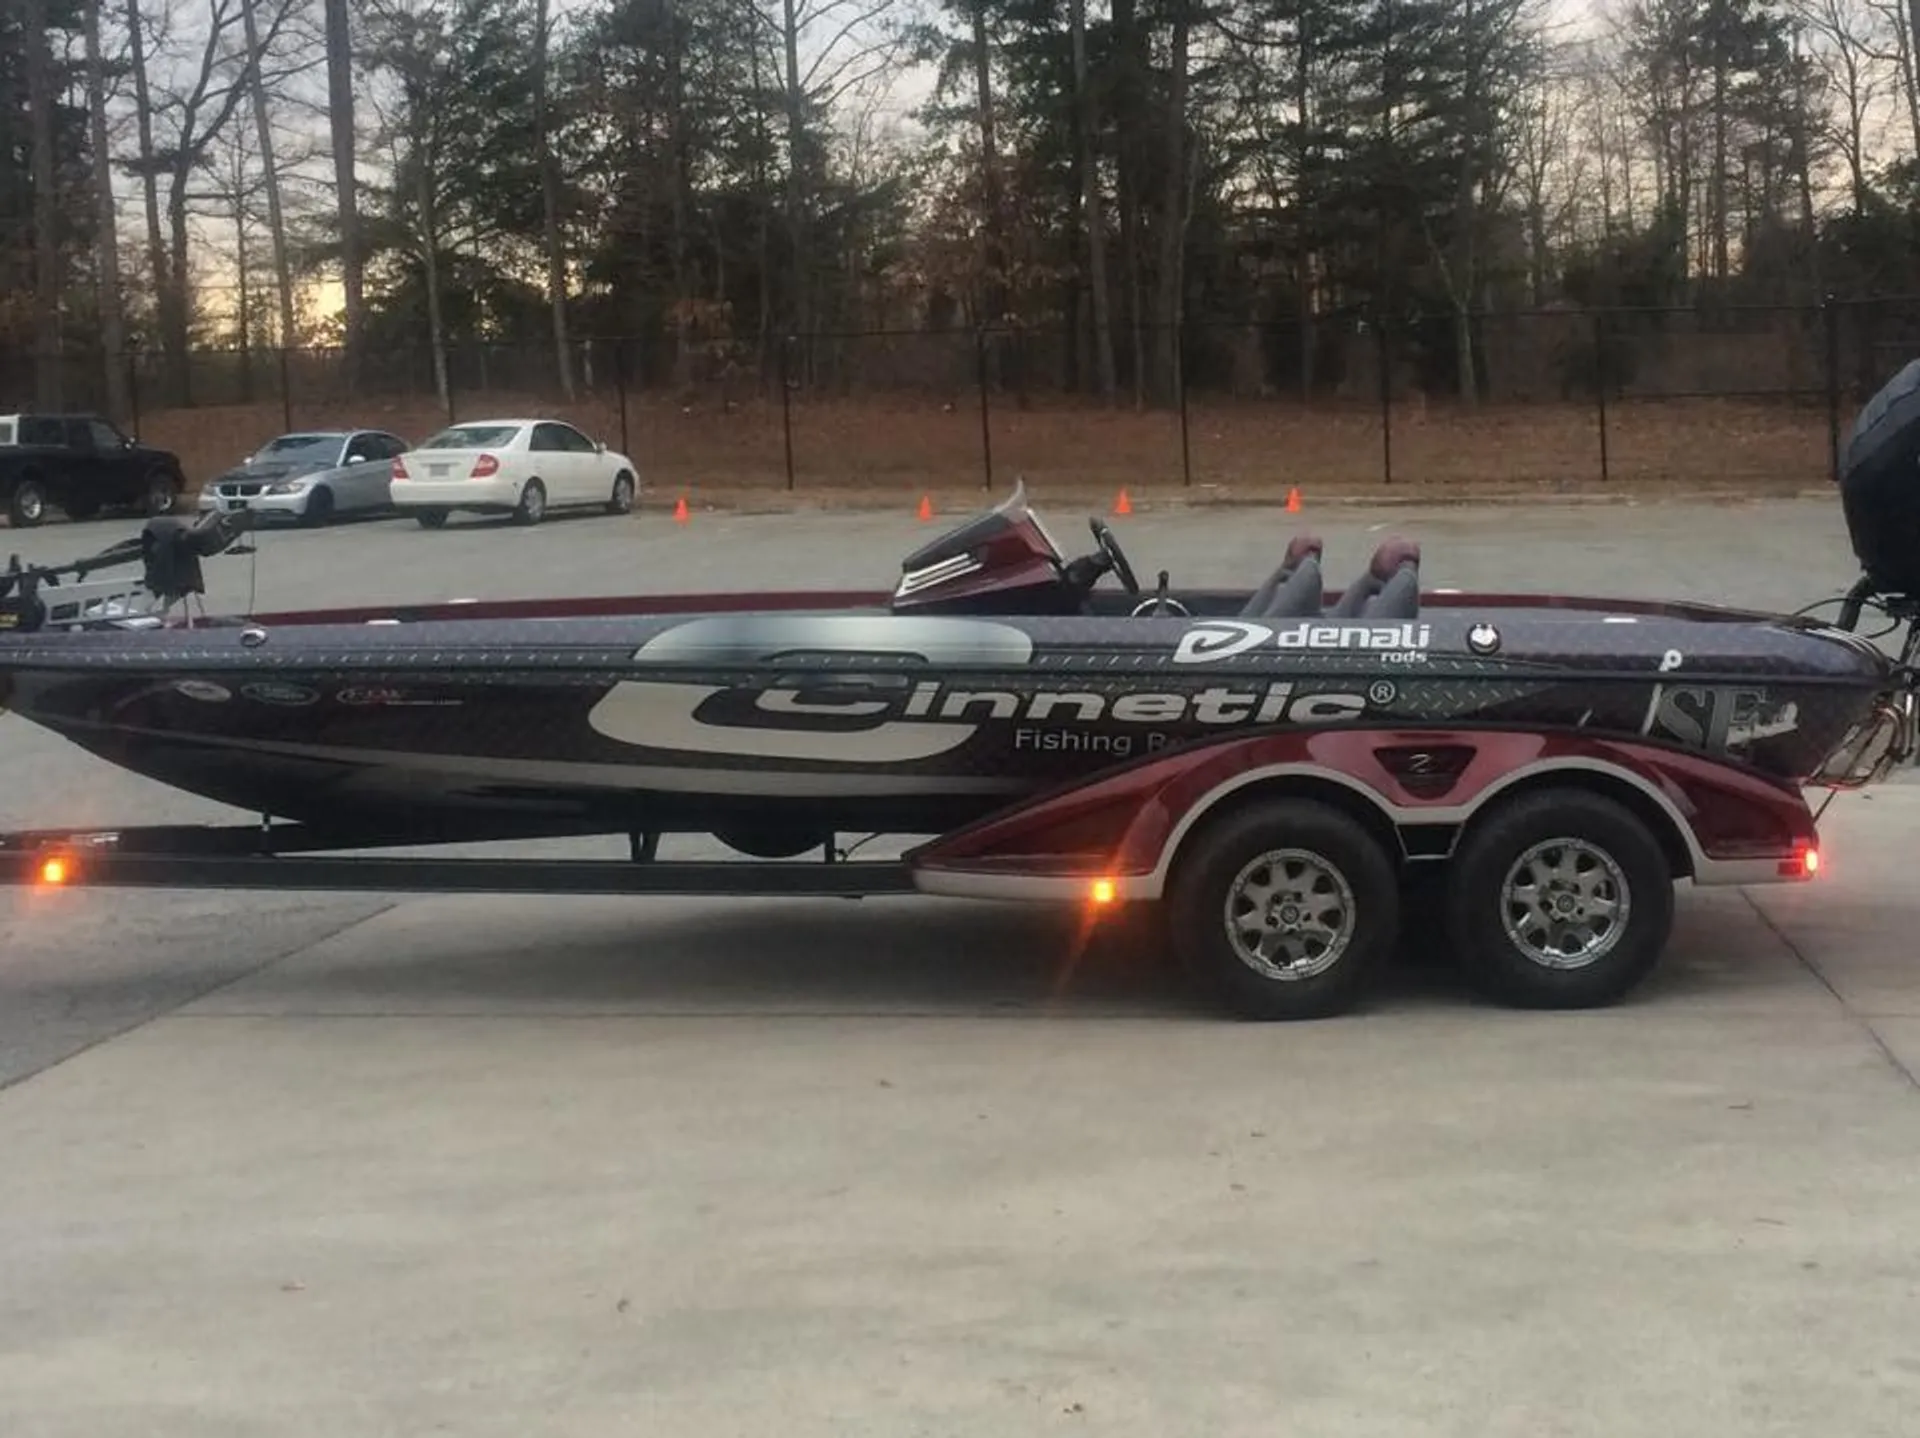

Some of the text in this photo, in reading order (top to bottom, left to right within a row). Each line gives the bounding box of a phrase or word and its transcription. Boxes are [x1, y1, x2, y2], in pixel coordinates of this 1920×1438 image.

[1277, 623, 1432, 649] denali
[1380, 650, 1428, 664] rods
[1014, 728, 1132, 756] Fishing
